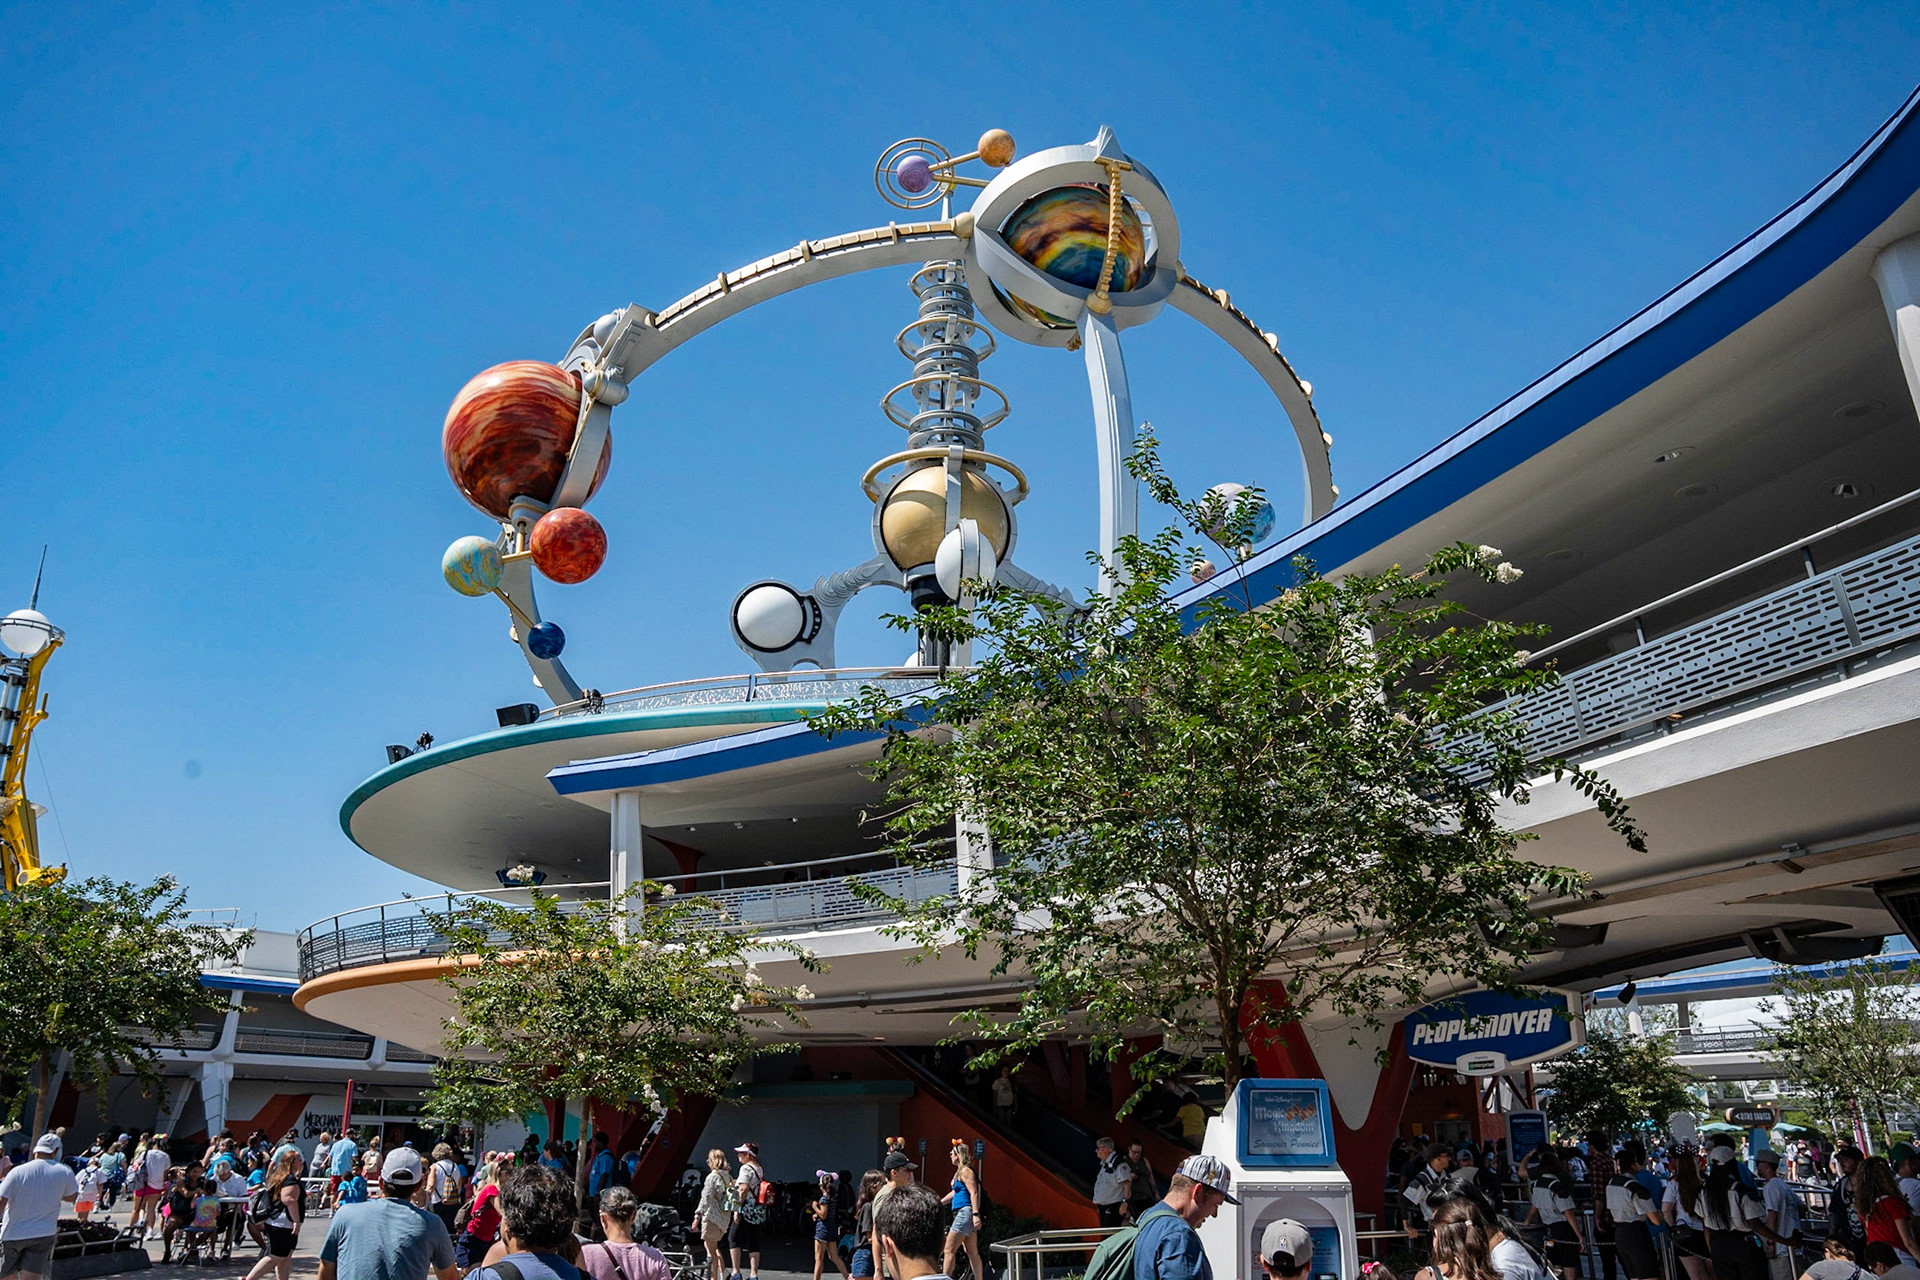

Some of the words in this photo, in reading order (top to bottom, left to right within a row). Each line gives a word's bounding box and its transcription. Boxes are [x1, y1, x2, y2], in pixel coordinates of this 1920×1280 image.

[1413, 1008, 1552, 1045] PEOPLEMOVER
[1254, 1106, 1285, 1121] Magic
[1274, 1121, 1314, 1134] Kingdom
[1253, 1139, 1287, 1149] Souvenir
[1290, 1138, 1319, 1149] Pennies
